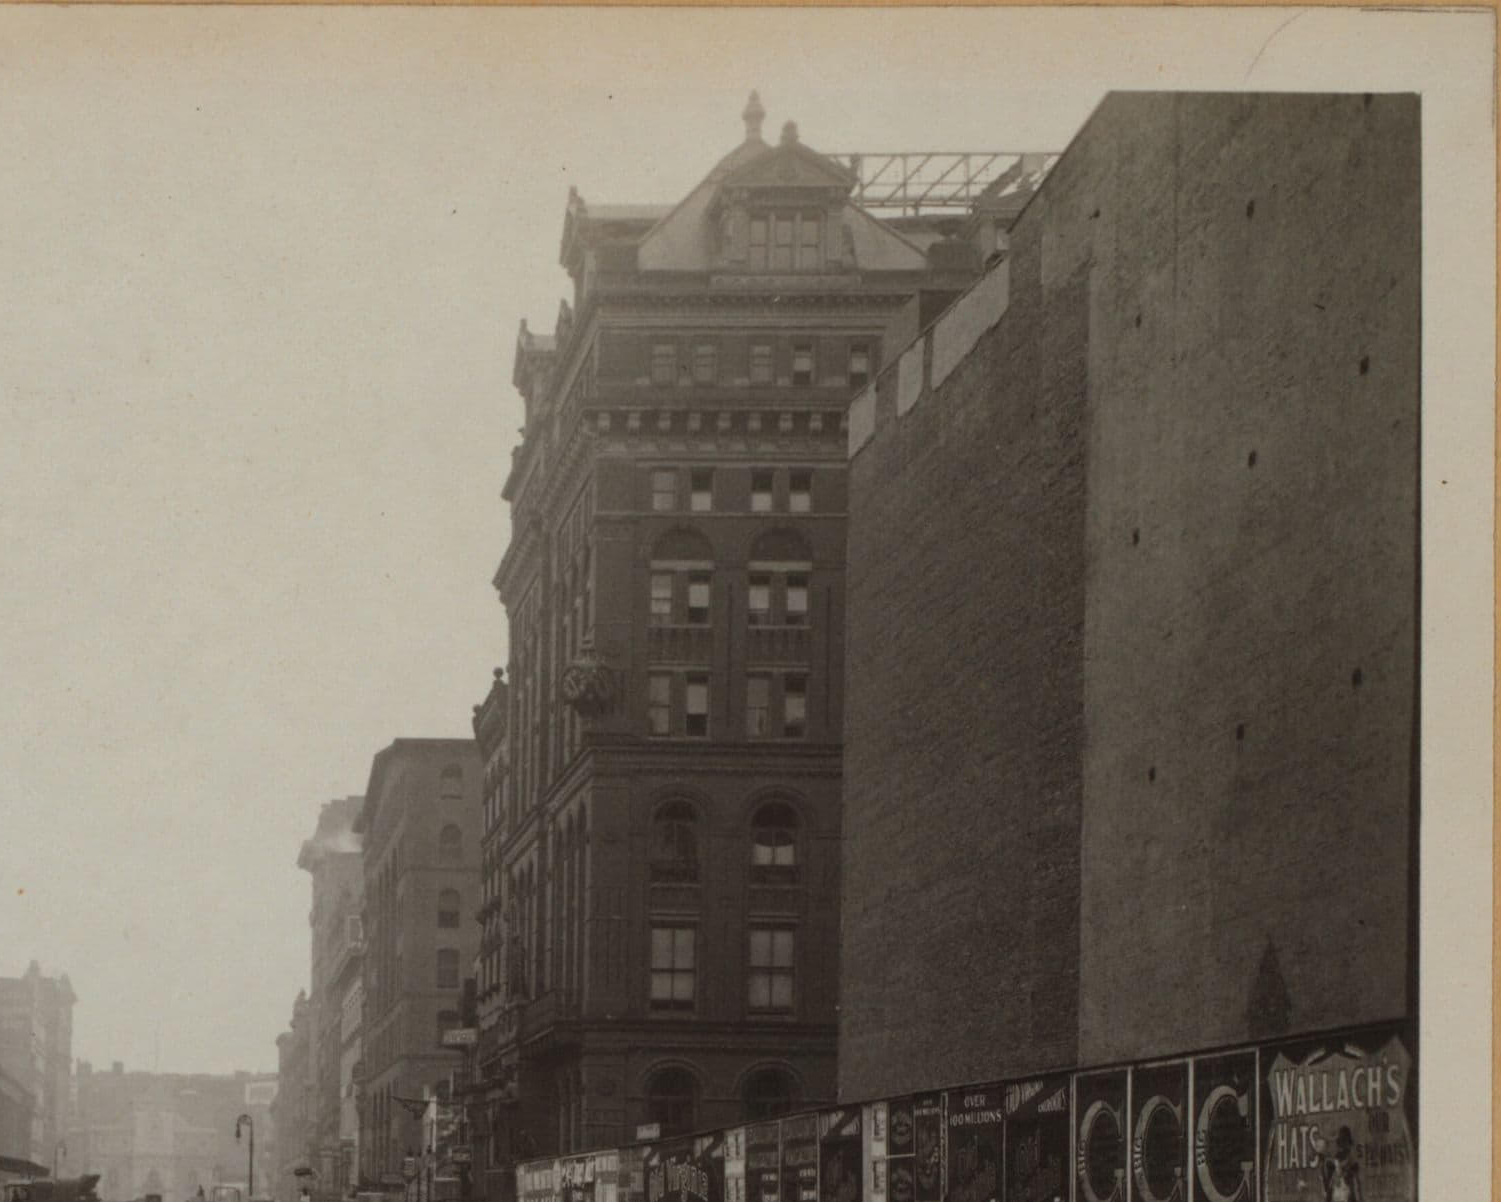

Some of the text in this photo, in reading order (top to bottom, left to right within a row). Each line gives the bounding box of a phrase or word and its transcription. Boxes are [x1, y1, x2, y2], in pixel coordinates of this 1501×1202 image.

[964, 1094, 987, 1108] OVER
[1276, 1055, 1401, 1117] WALLACH'S
[964, 1109, 1002, 1124] MILLIONS
[1277, 1121, 1320, 1171] HATS
